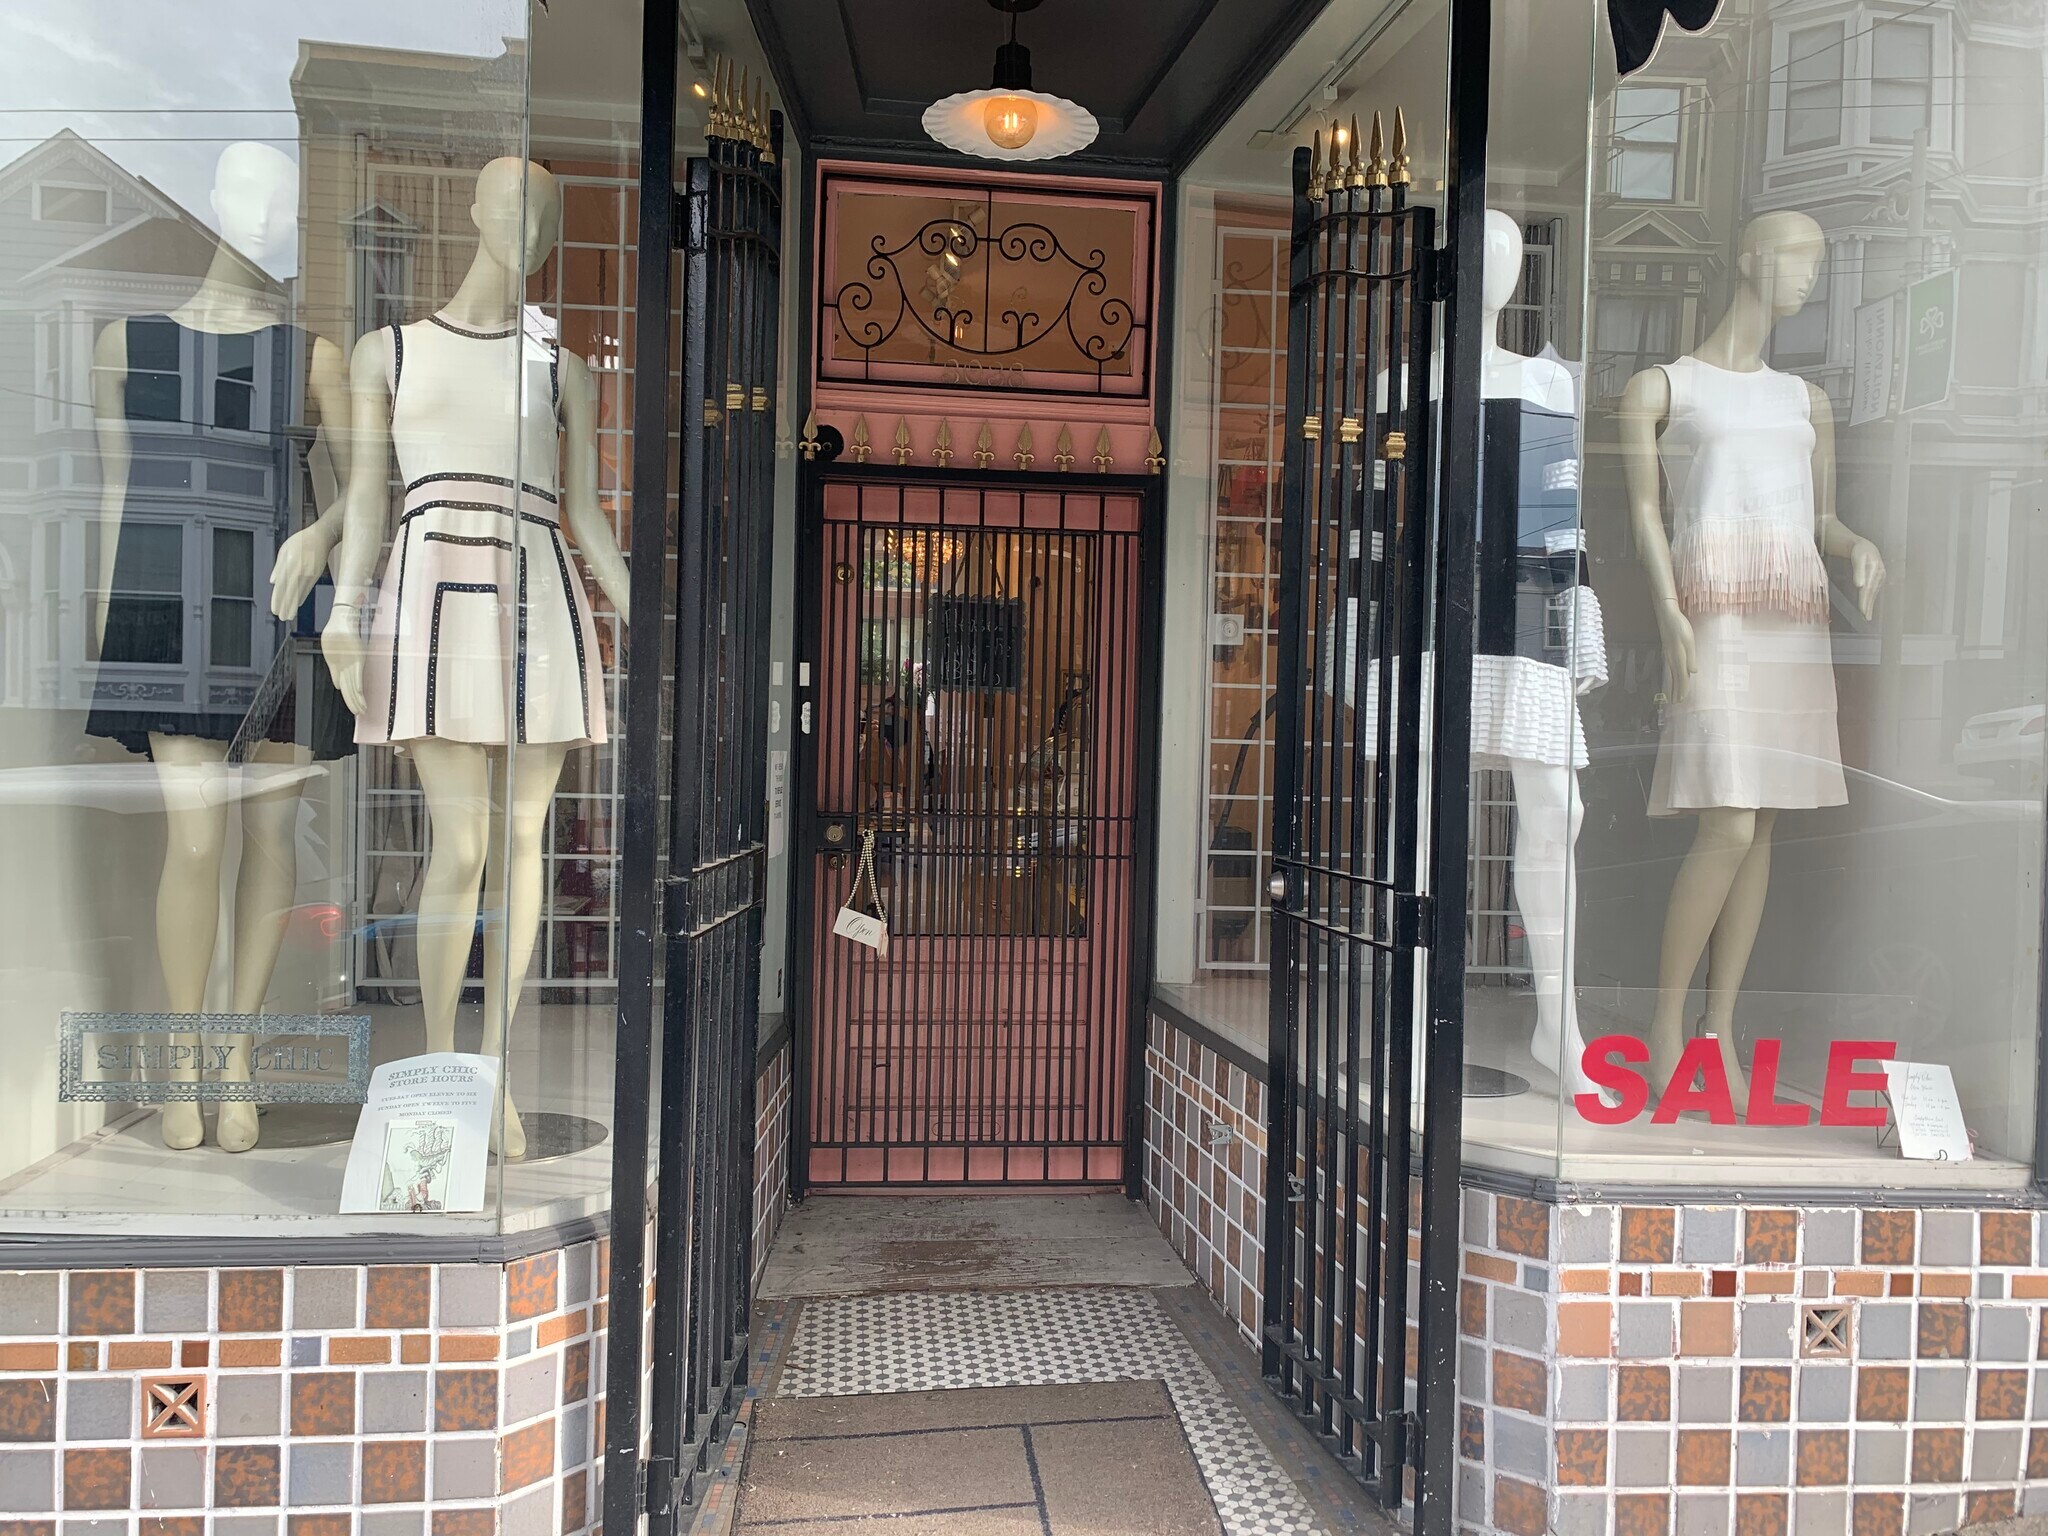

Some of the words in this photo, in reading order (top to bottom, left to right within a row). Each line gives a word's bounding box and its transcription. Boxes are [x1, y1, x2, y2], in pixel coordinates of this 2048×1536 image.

[845, 916, 873, 939] Open
[97, 1045, 236, 1070] SIMPLY
[252, 1046, 334, 1072] CHIC
[388, 1065, 438, 1081] SIMPLY
[442, 1065, 478, 1075] CHIC
[389, 1078, 428, 1088] STORE
[430, 1075, 474, 1083] HOURS
[1574, 1034, 1897, 1127] SALE
